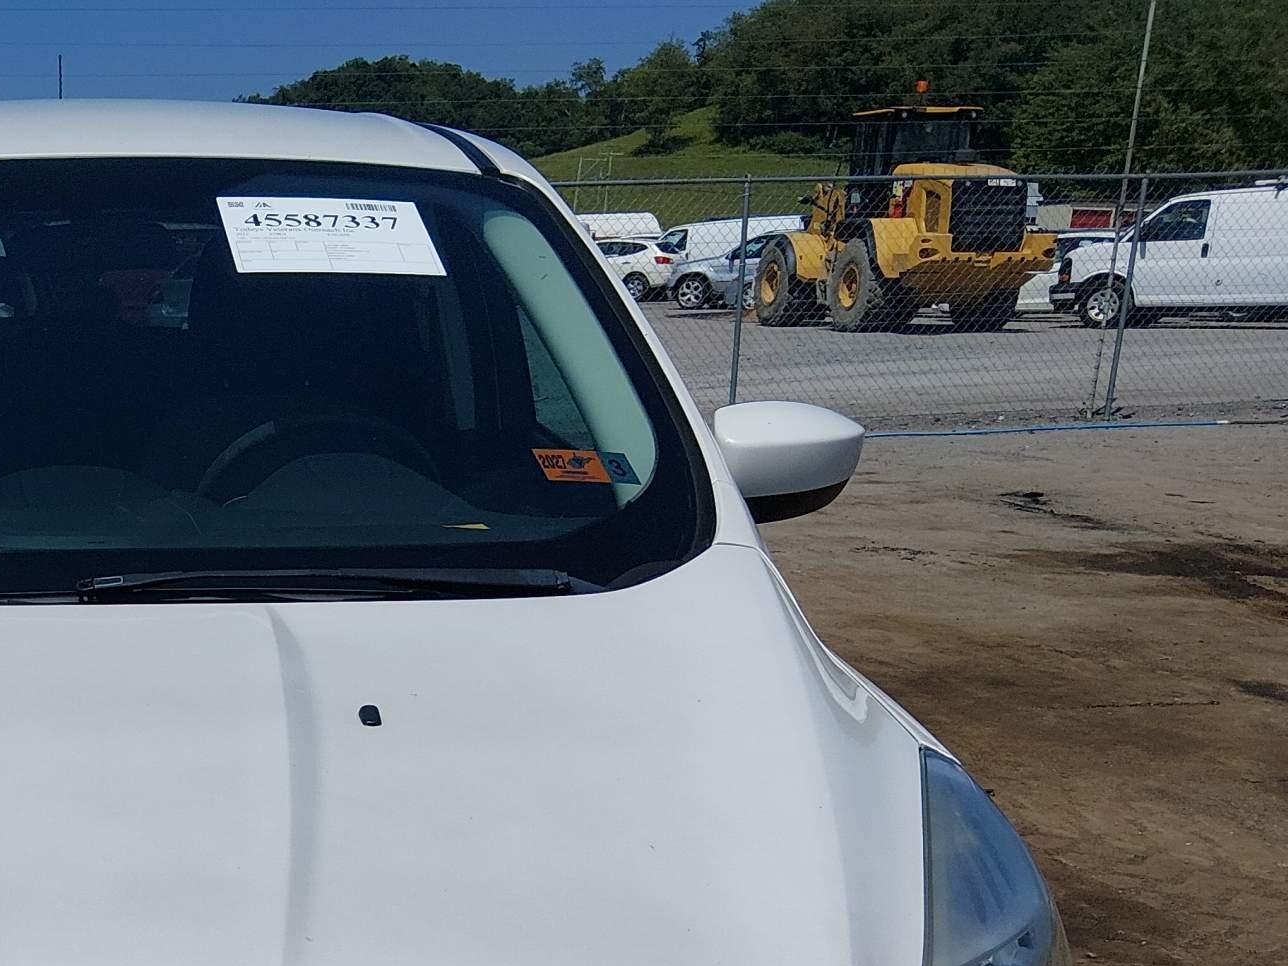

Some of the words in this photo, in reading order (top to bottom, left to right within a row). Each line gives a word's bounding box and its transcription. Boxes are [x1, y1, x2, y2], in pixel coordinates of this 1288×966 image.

[244, 213, 398, 230] 45587337
[538, 454, 567, 470] 2027
[608, 458, 627, 477] 3
